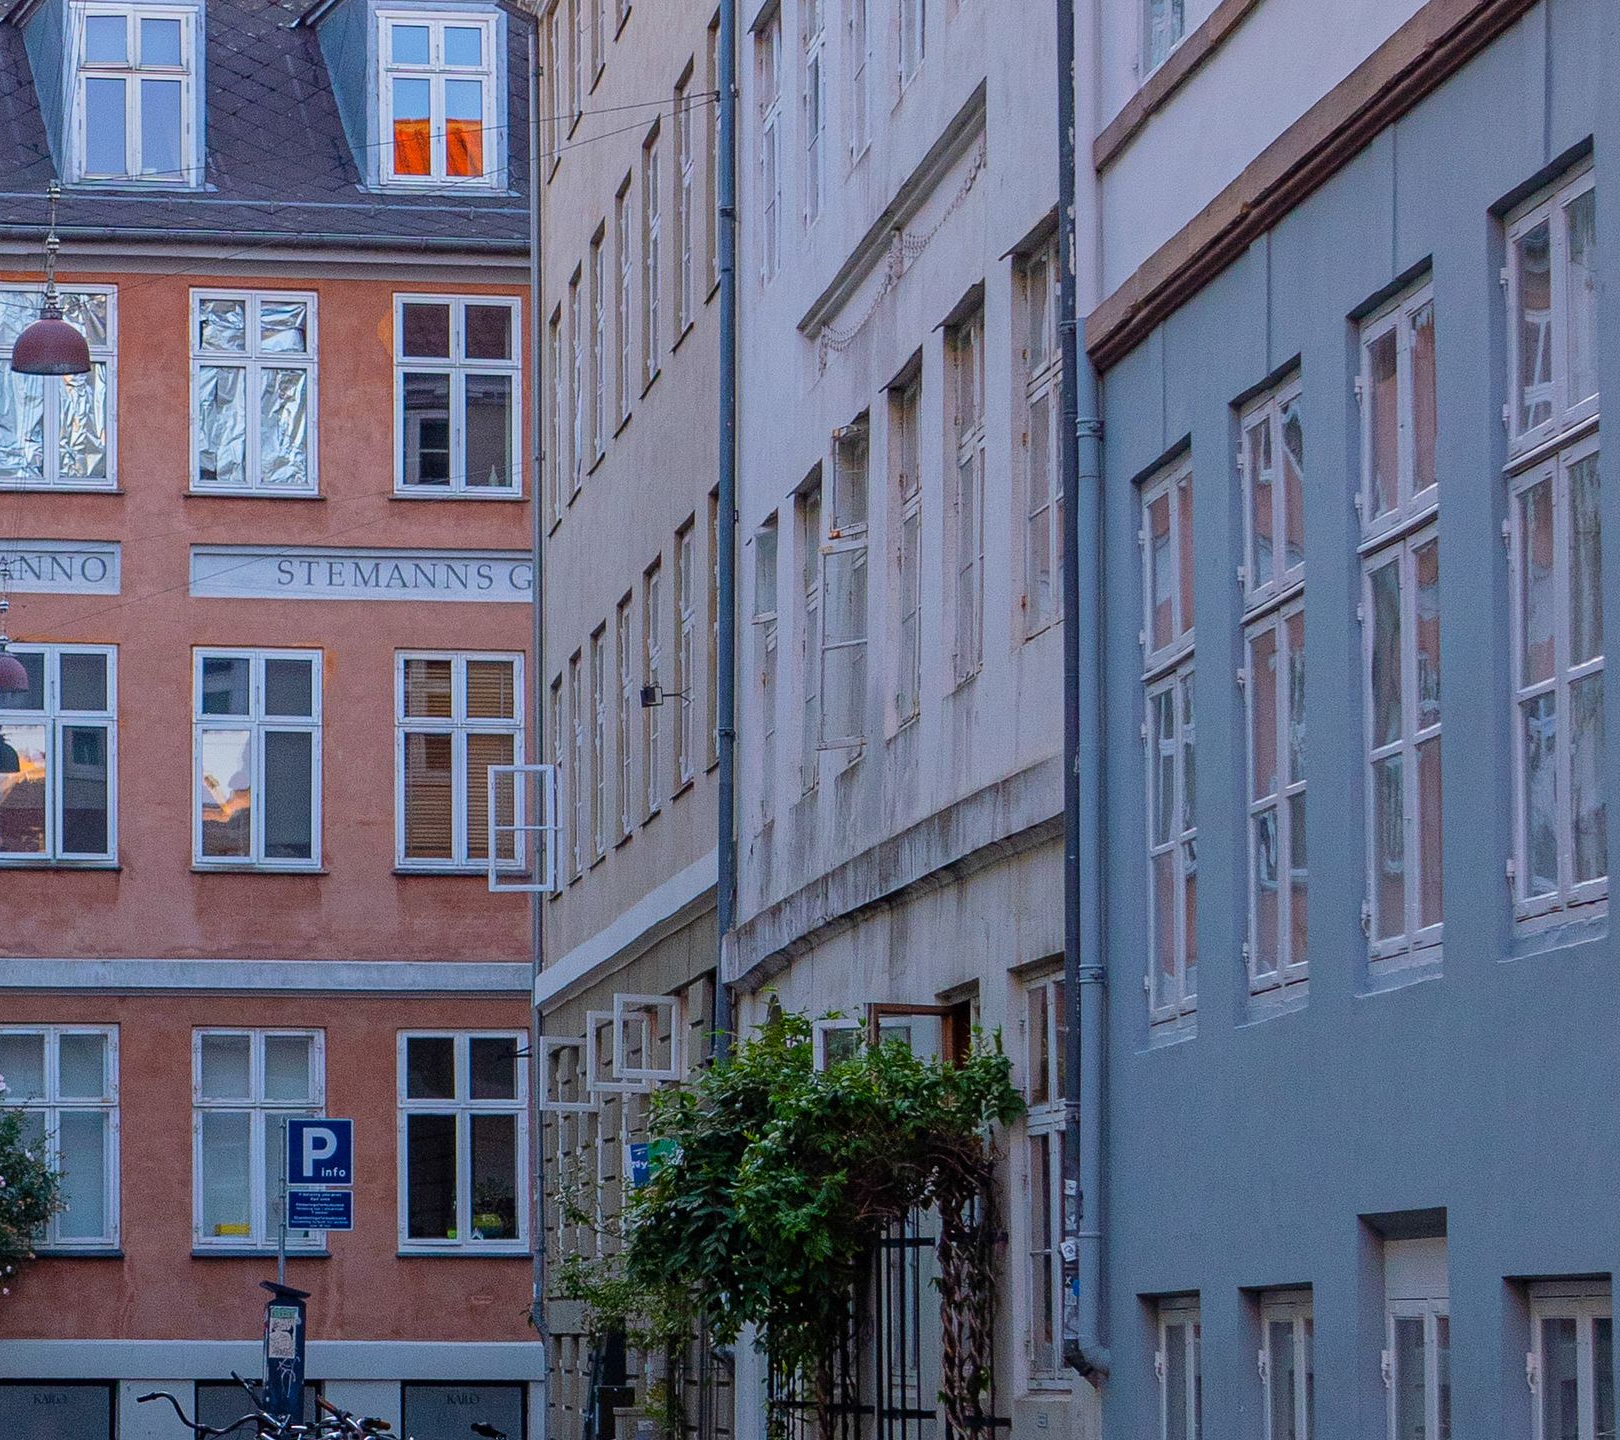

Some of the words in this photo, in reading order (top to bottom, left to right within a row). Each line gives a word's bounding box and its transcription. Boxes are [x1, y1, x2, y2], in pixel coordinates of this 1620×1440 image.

[277, 560, 494, 590] STEMANNS
[303, 1127, 338, 1177] P
[321, 1167, 347, 1177] info
